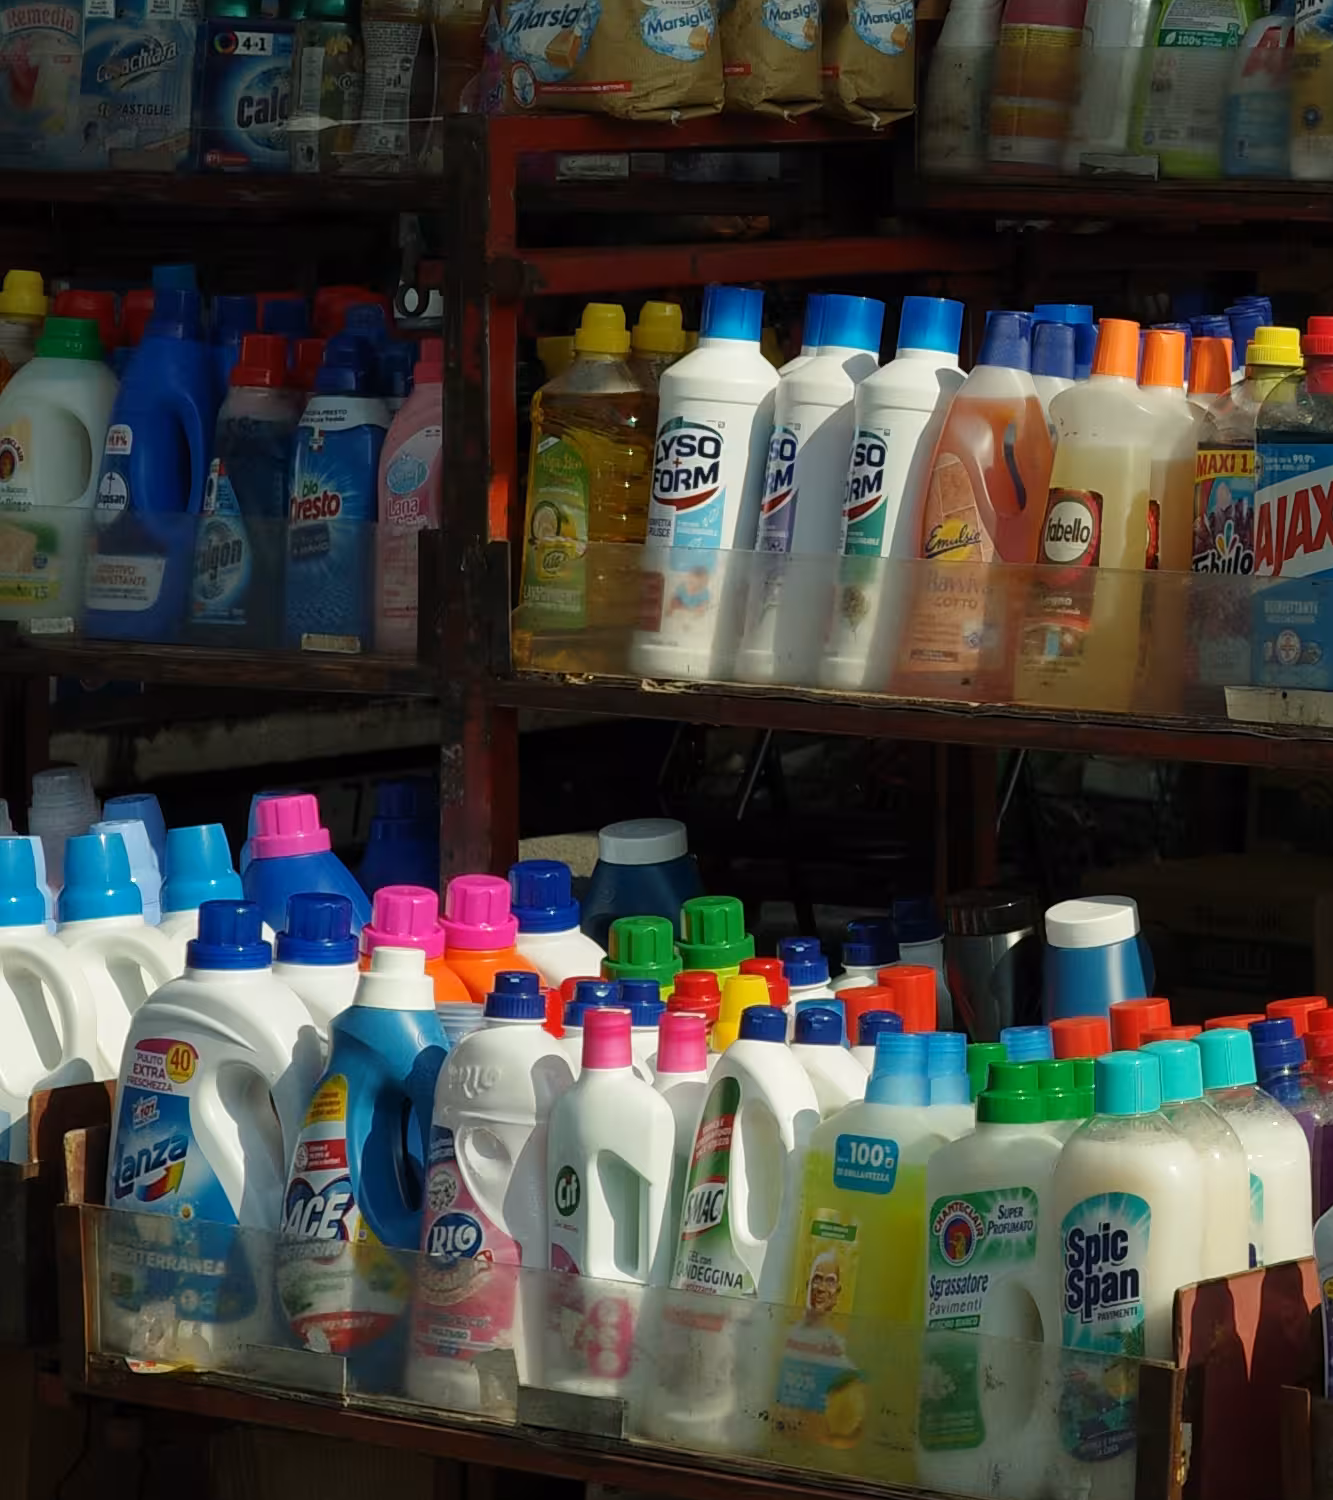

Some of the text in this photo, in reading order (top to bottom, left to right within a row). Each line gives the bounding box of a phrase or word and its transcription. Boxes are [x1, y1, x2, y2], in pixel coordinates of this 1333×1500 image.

[655, 432, 722, 464] LYSO
[1197, 451, 1237, 475] MAXI
[652, 461, 720, 493] FORM
[386, 498, 420, 519] Lana
[925, 524, 982, 559] Emulsio
[1044, 512, 1092, 547] fabello
[132, 1063, 166, 1080] EXTRA
[136, 1051, 164, 1067] PULITO
[170, 1047, 192, 1072] 40
[127, 1075, 174, 1093] FRESCHEZZA
[557, 1171, 580, 1208] Cif
[284, 1191, 354, 1240] ACE
[933, 1200, 986, 1240] CHANTECLAIR
[997, 1204, 1024, 1221] SUPER
[430, 1222, 477, 1256] RIO
[987, 1216, 1034, 1236] PROFUMATO
[1067, 1223, 1129, 1272] Spic
[929, 1272, 988, 1298] Sgrassatore
[1065, 1267, 1139, 1320] Span
[929, 1298, 982, 1317] Pavimenti
[1097, 1305, 1139, 1322] PAVIMENTI
